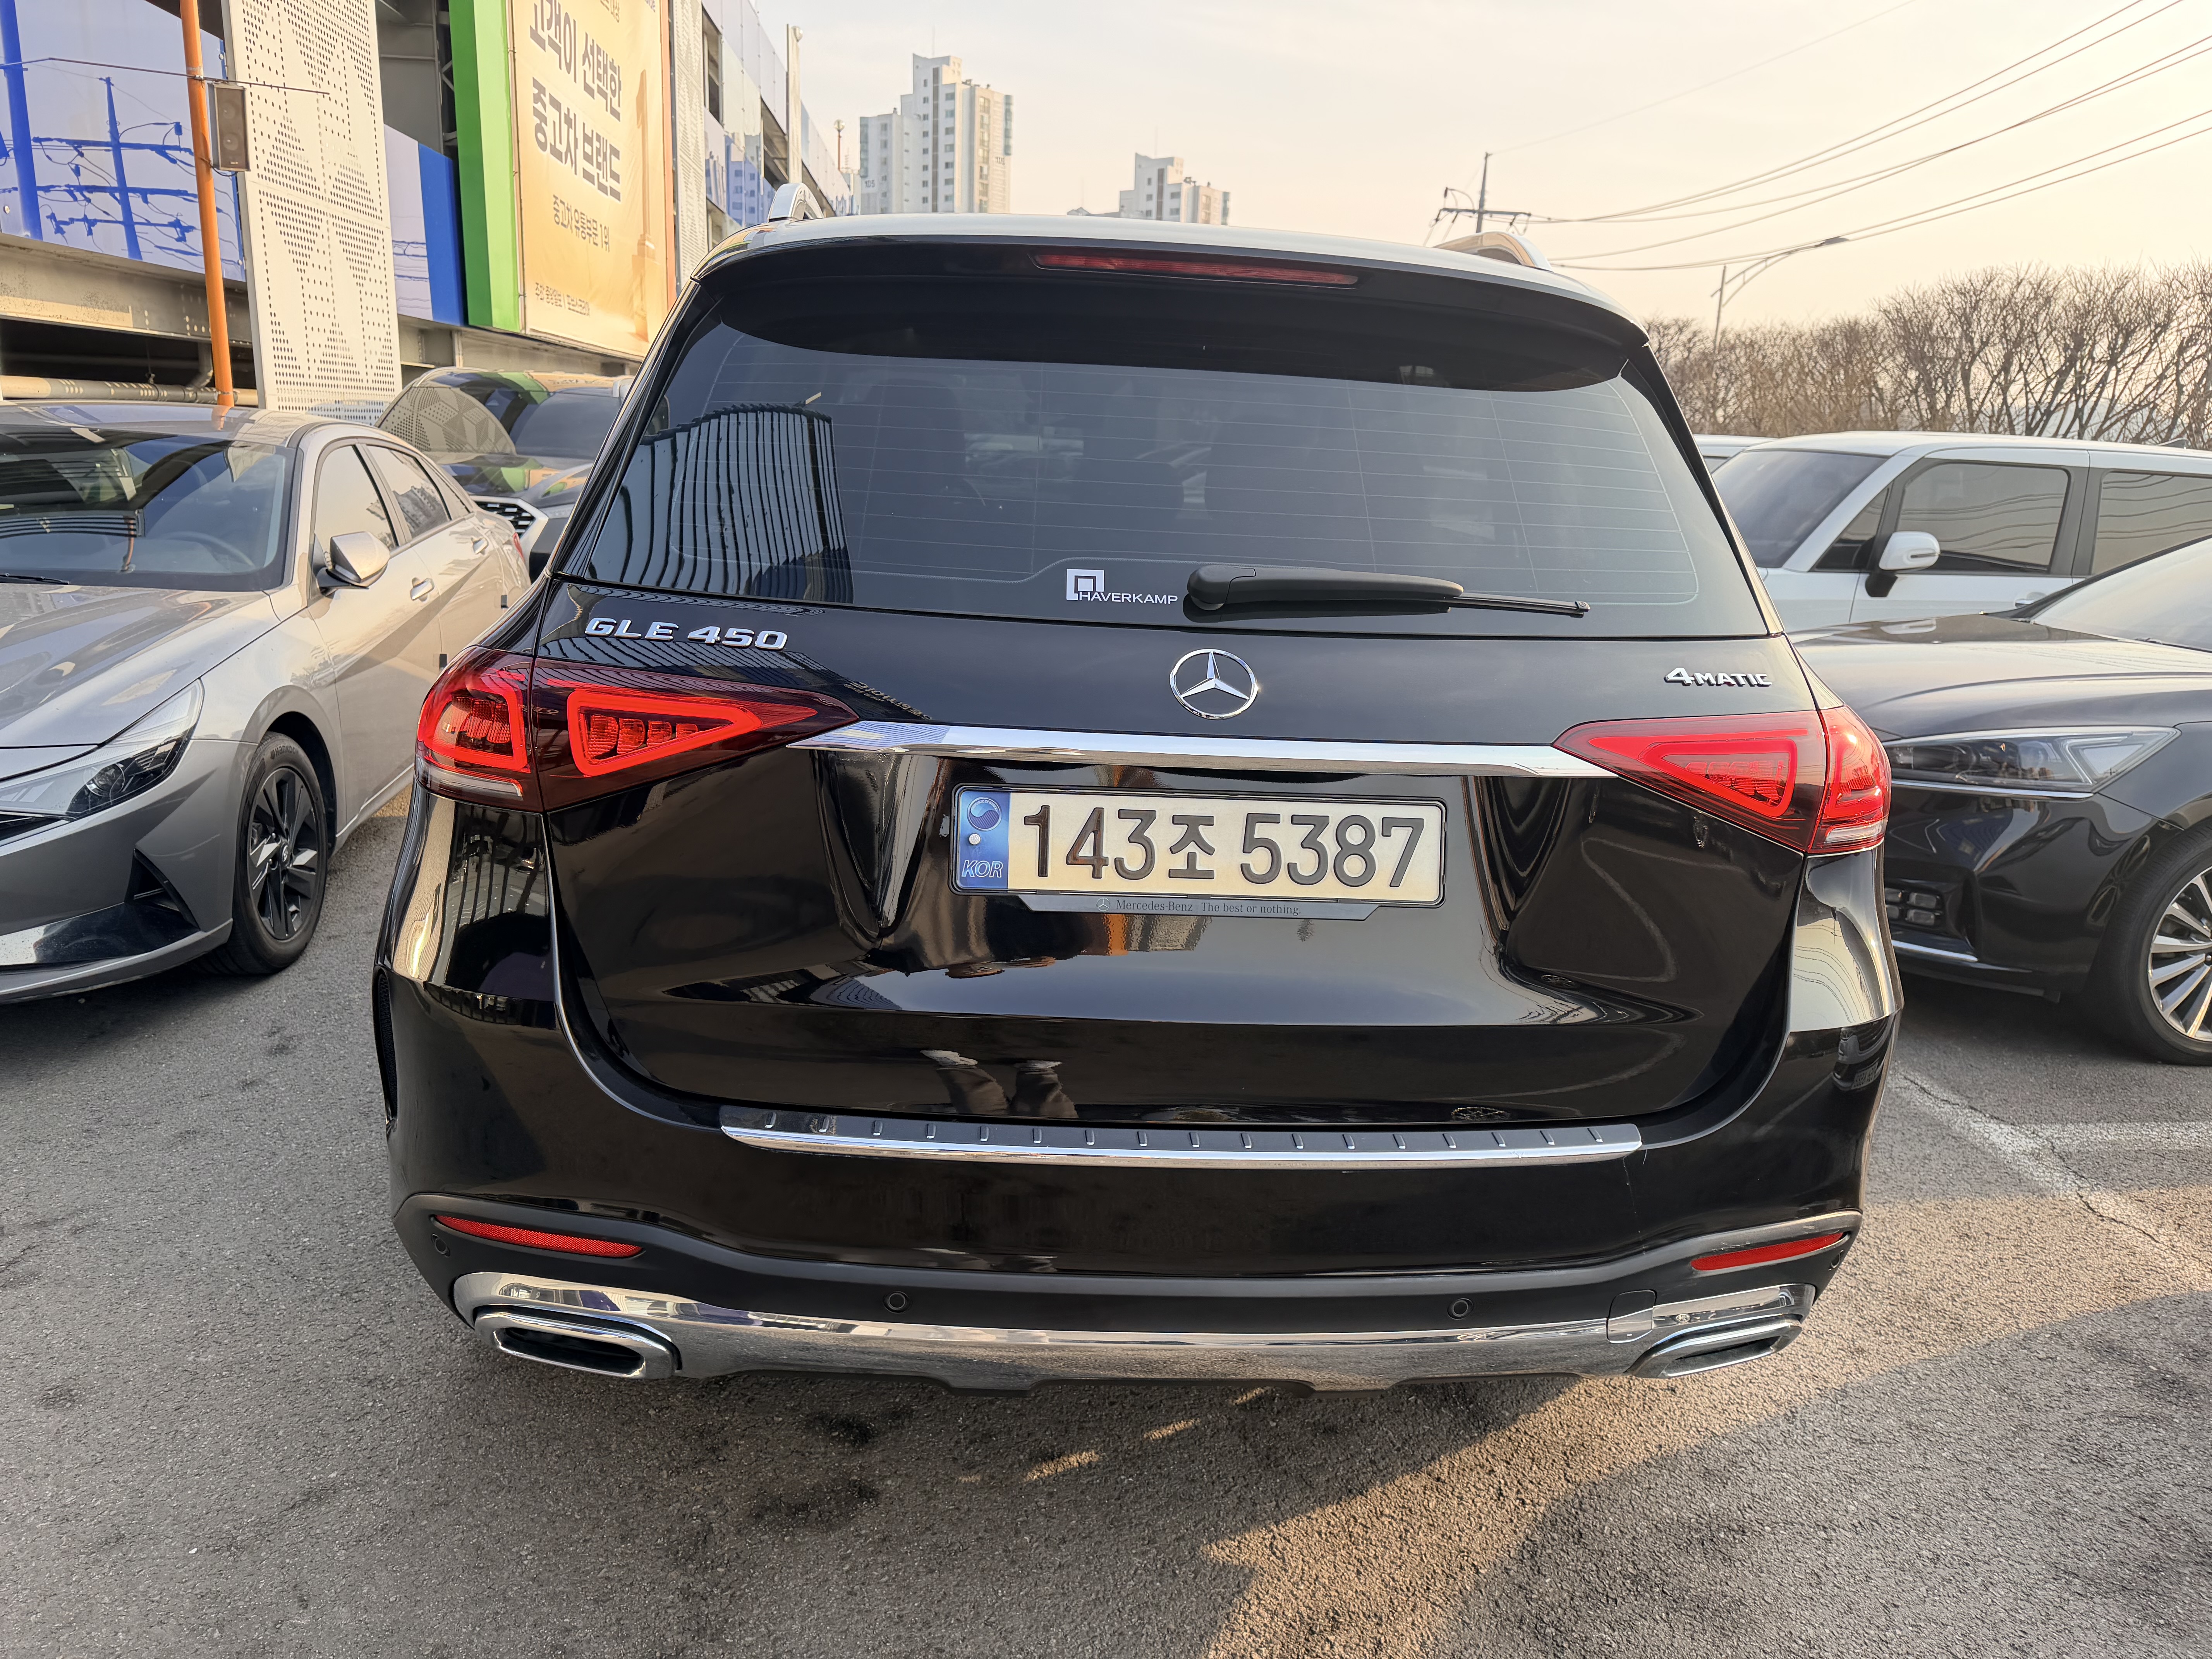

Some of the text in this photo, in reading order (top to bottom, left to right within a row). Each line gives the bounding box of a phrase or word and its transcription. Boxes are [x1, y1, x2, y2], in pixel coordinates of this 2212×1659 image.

[530, 0, 622, 122] 고객이 선택한
[532, 76, 621, 202] 중고차 브랜드
[553, 194, 610, 253] 중고차 유통부문 1위
[1079, 591, 1178, 605] HAVERKAMP
[584, 617, 788, 650] GLE 450
[1664, 667, 1772, 687] 4MATIC
[1024, 805, 1425, 888] 143조 5387
[961, 860, 1003, 878] KOR
[1116, 899, 1193, 911] Mercedes-Benz
[1201, 902, 1219, 912] The
[1223, 903, 1243, 913] best
[1260, 904, 1301, 916] nothing.
